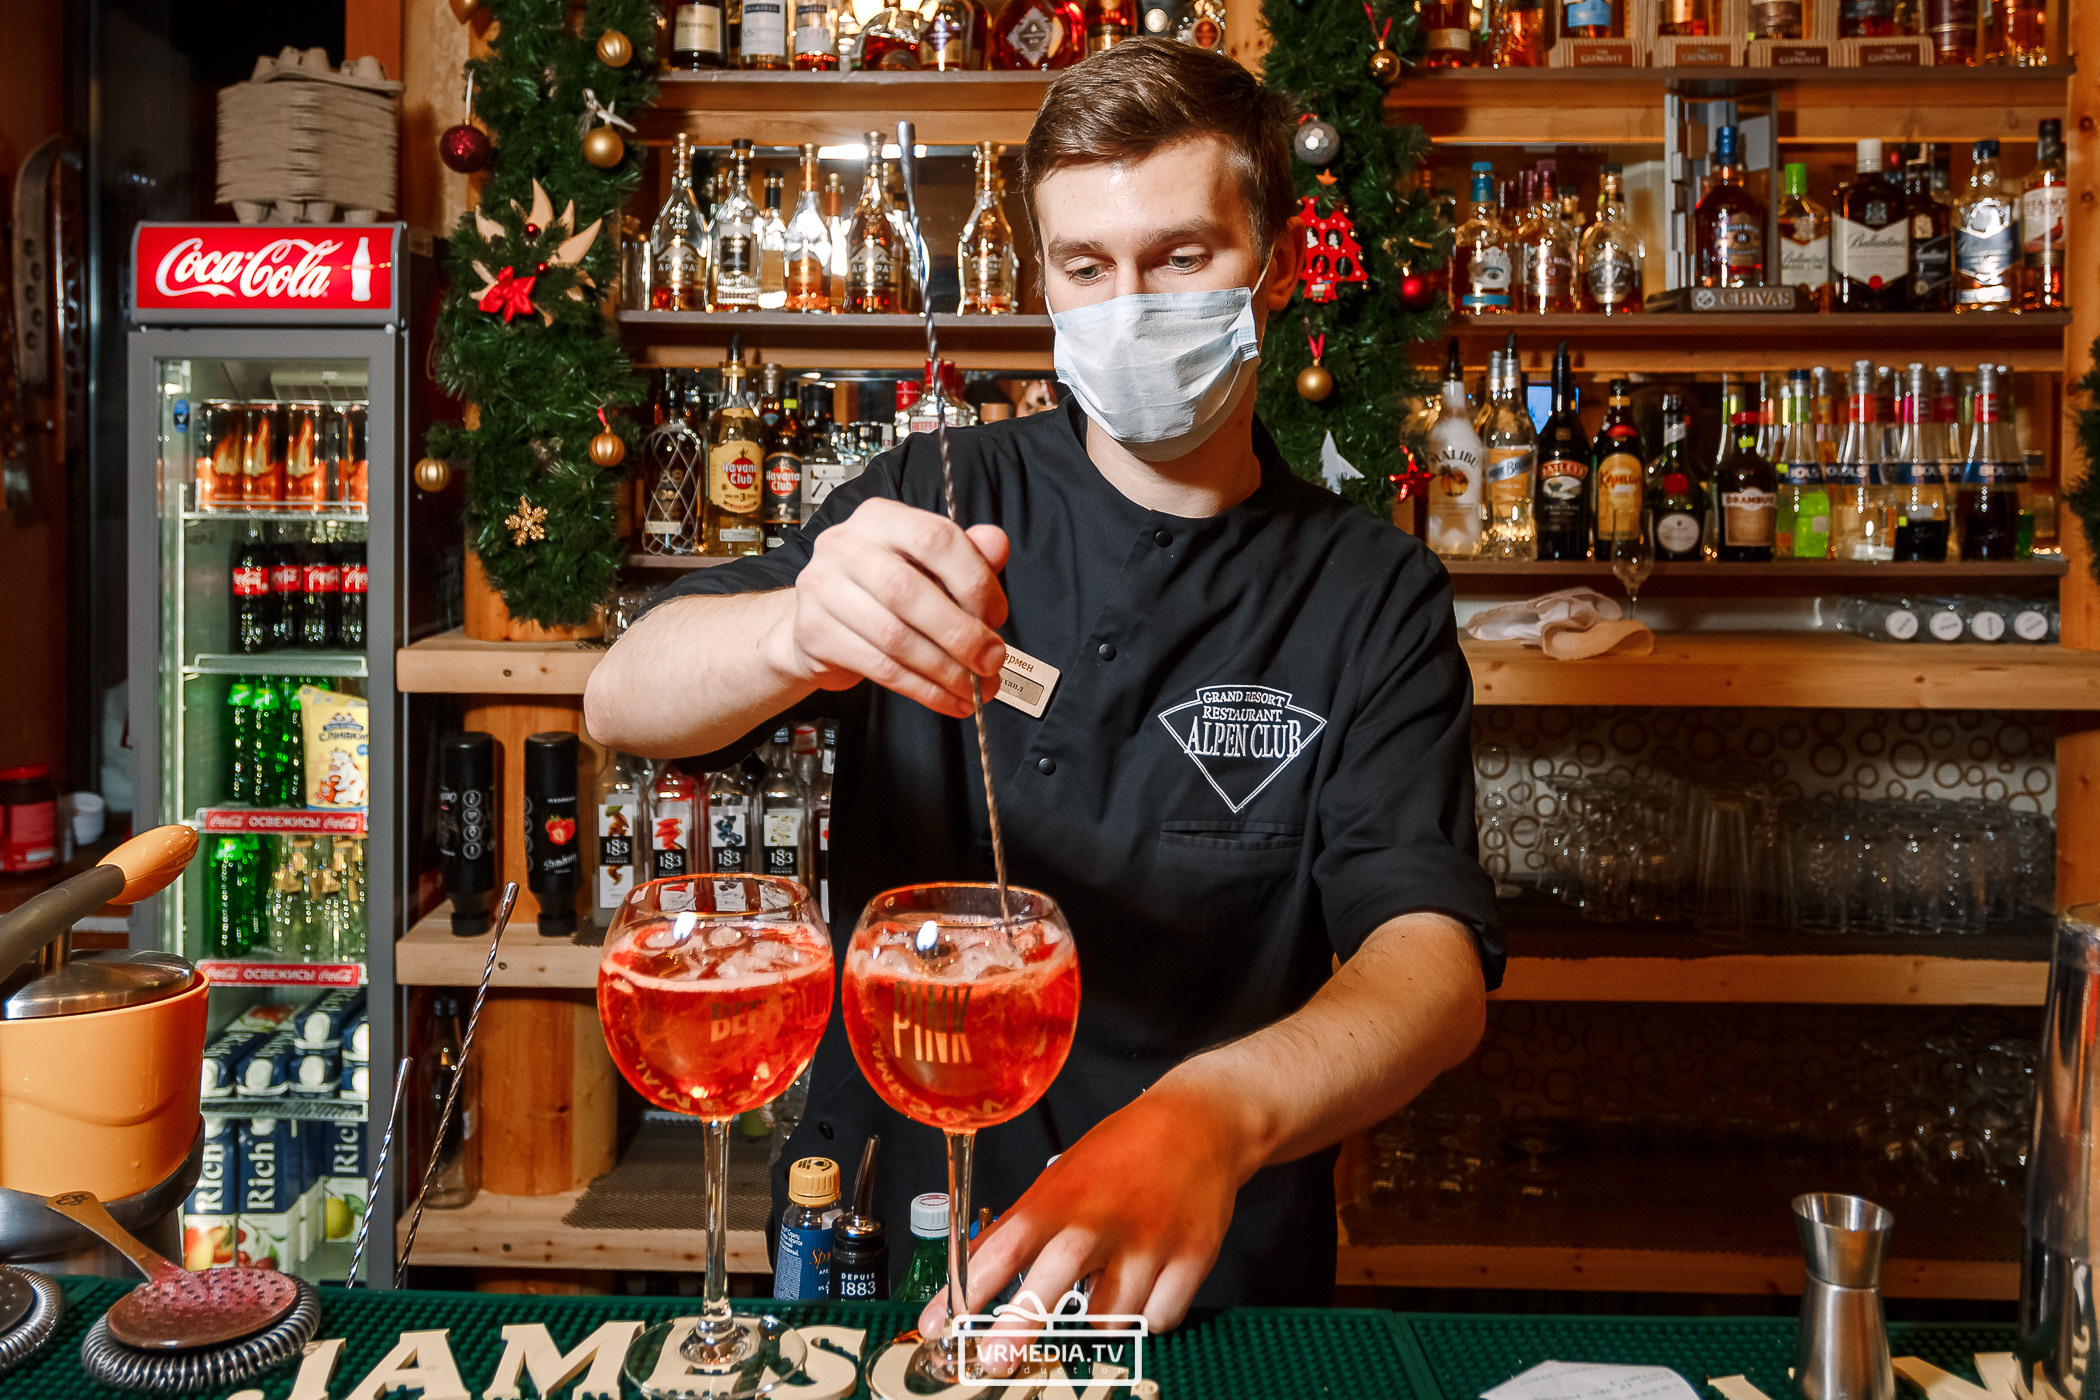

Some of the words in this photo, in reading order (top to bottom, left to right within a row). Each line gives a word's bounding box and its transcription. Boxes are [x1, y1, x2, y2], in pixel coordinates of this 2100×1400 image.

[679, 20, 713, 30] Hennessy
[155, 237, 344, 299] Coca-Cola
[657, 262, 700, 272] ARRAT
[851, 264, 894, 274] ARRAT
[1720, 291, 1790, 307] CHIVAS
[1430, 450, 1479, 468] MALIBU
[722, 462, 758, 473] Havana
[730, 473, 753, 485] Club
[766, 471, 800, 481] Havana
[771, 482, 793, 491] Club
[777, 503, 788, 516] 7
[1004, 653, 1034, 673] армен
[1000, 678, 1024, 693] хаил
[1203, 690, 1243, 704] GRAND
[1245, 691, 1286, 708] RESORT
[1202, 705, 1284, 723] RESTAURANT
[210, 813, 243, 828] Coca-Cola
[248, 816, 321, 828] ОСВЕЖИСЬ!
[323, 814, 358, 829] Coca-Cola
[243, 969, 315, 981] ОСВЕЖИСЬ!
[318, 969, 353, 983] Coca-Cola
[893, 981, 972, 1064] PINK
[195, 1143, 225, 1212] Rich
[246, 1142, 276, 1210] Rich
[841, 1272, 875, 1281] DEPUIS
[841, 1281, 876, 1296] 1883
